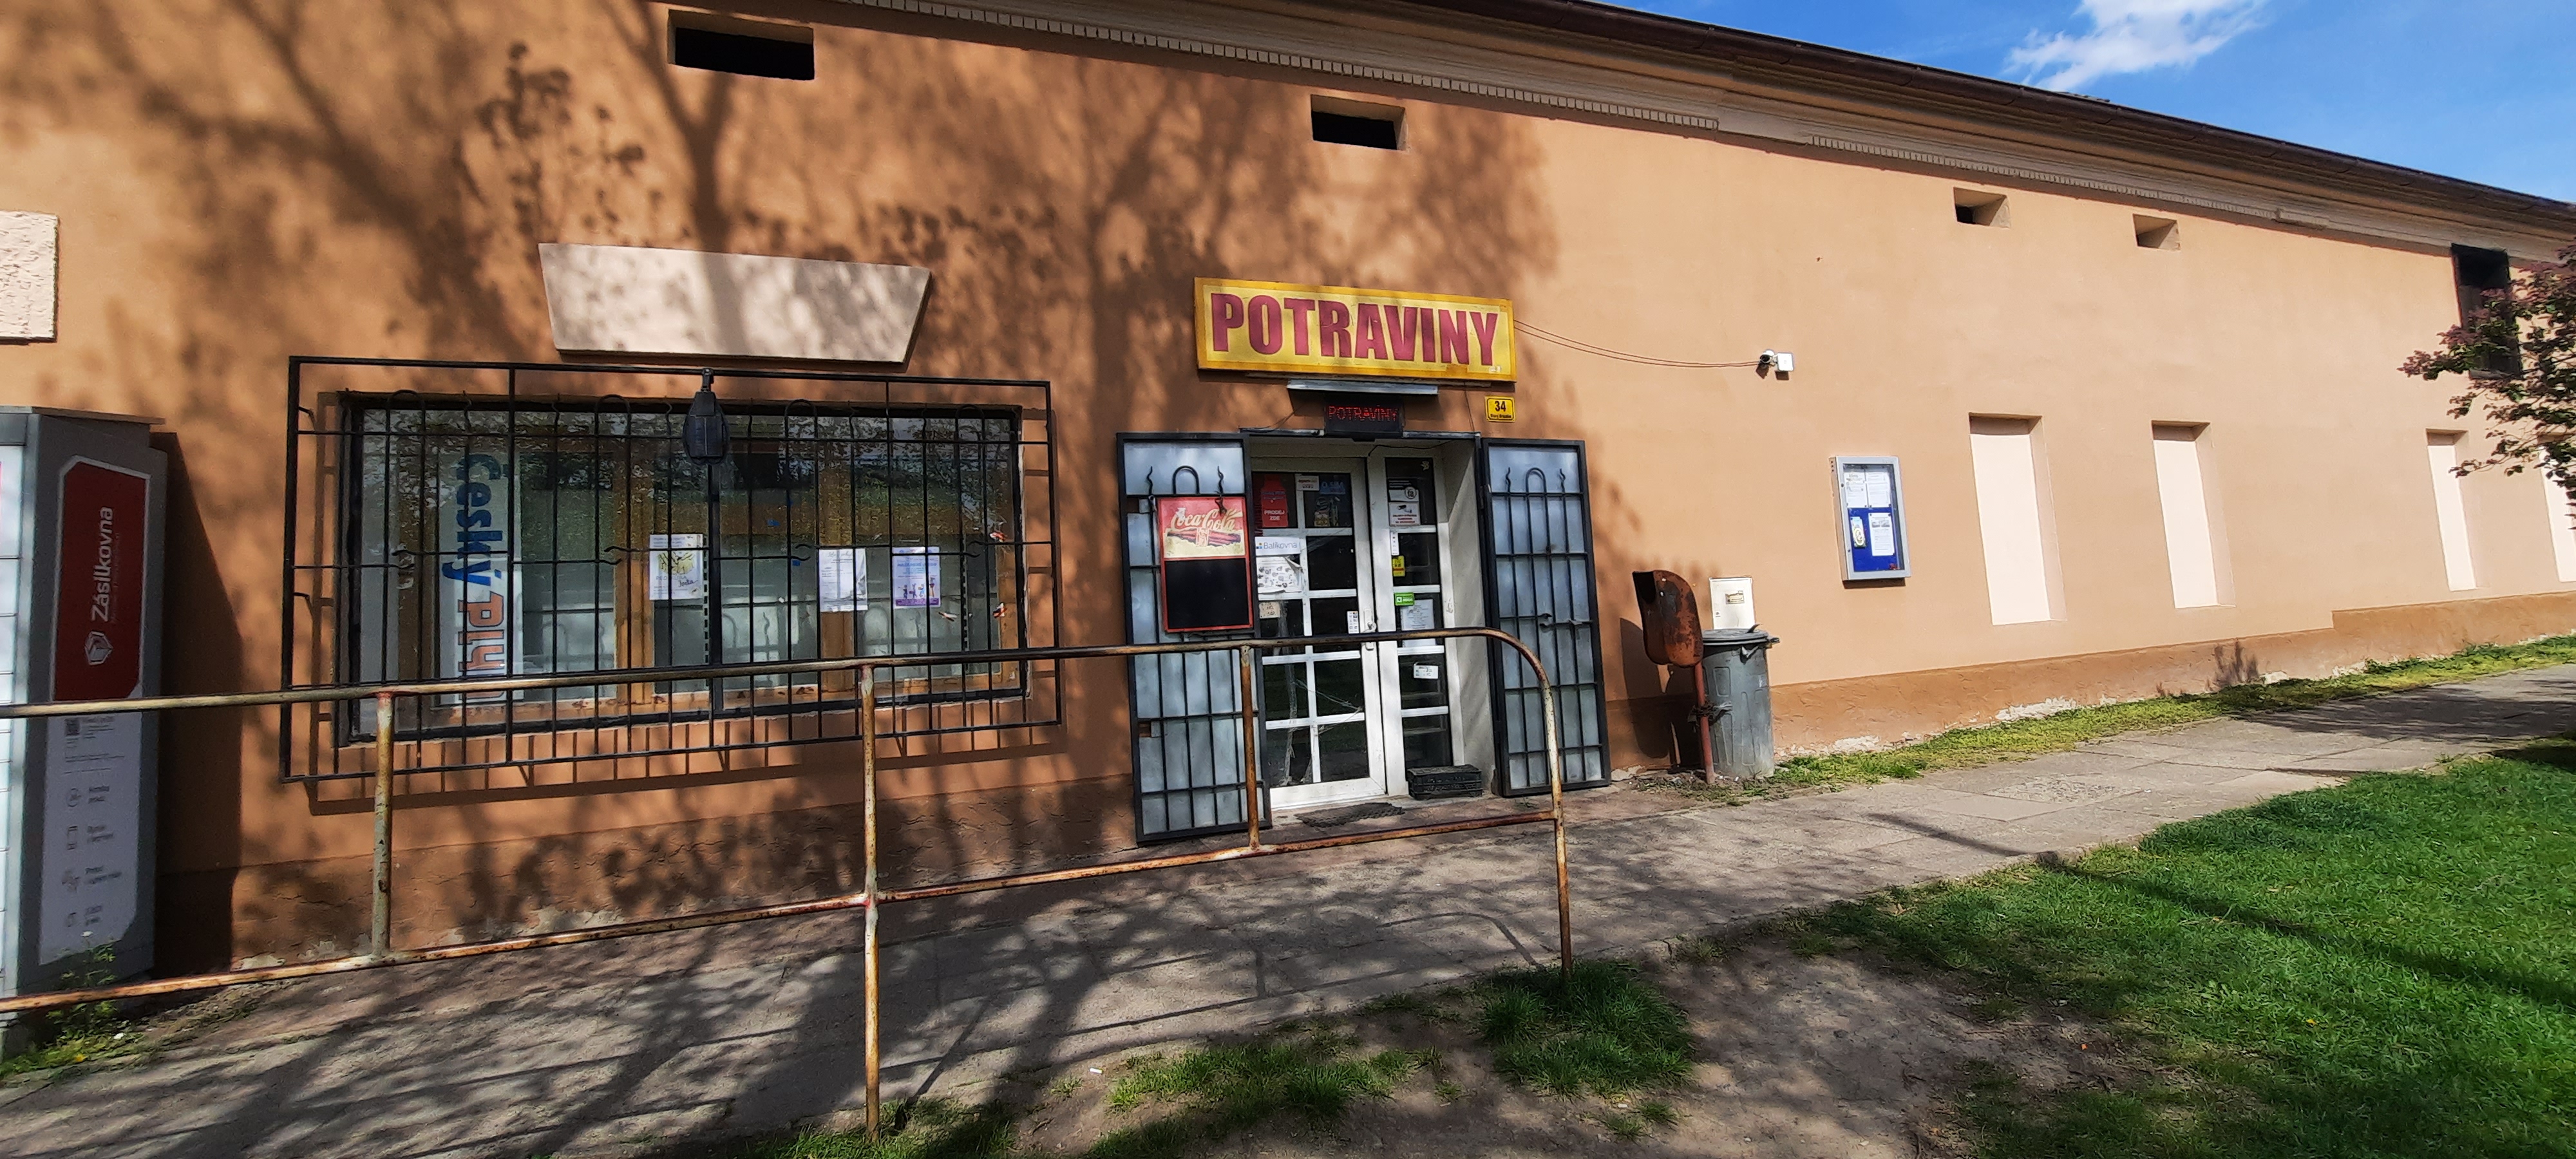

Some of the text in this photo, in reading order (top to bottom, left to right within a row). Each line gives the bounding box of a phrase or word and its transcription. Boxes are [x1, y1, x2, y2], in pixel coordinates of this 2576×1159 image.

[1211, 293, 1498, 366] POTRAVINY
[1495, 400, 1506, 412] 34
[1170, 507, 1244, 532] Coca-Cola
[1264, 542, 1298, 550] Balíkovna
[91, 506, 113, 623] Zásilkovna
